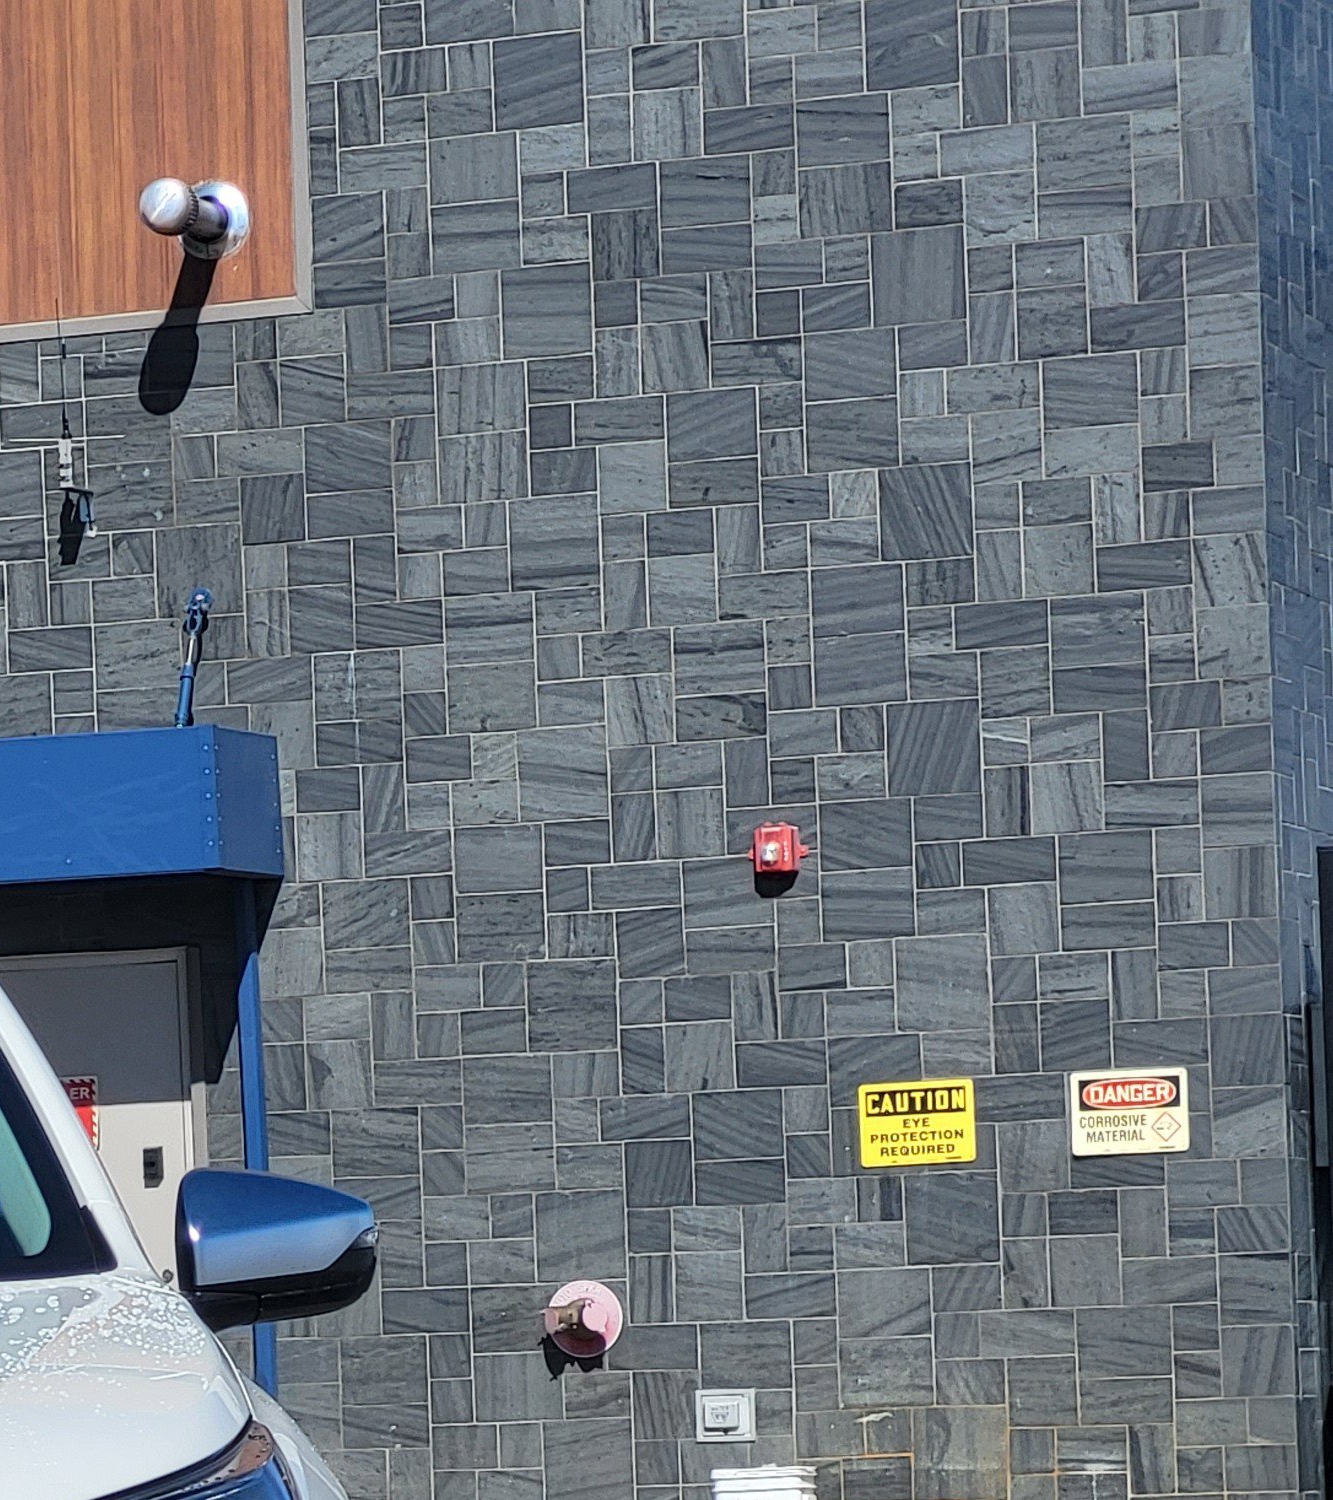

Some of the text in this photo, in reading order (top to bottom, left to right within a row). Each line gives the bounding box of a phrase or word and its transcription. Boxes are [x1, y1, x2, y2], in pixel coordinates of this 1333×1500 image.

[1089, 1083, 1170, 1104] DANGER
[866, 1089, 965, 1114] CAUTION
[902, 1117, 930, 1128] EYE
[1079, 1114, 1147, 1128] CORROSIVE
[870, 1129, 964, 1144] PROTECTION
[1086, 1129, 1145, 1143] MATERIAL
[880, 1143, 955, 1157] REQUIRED
